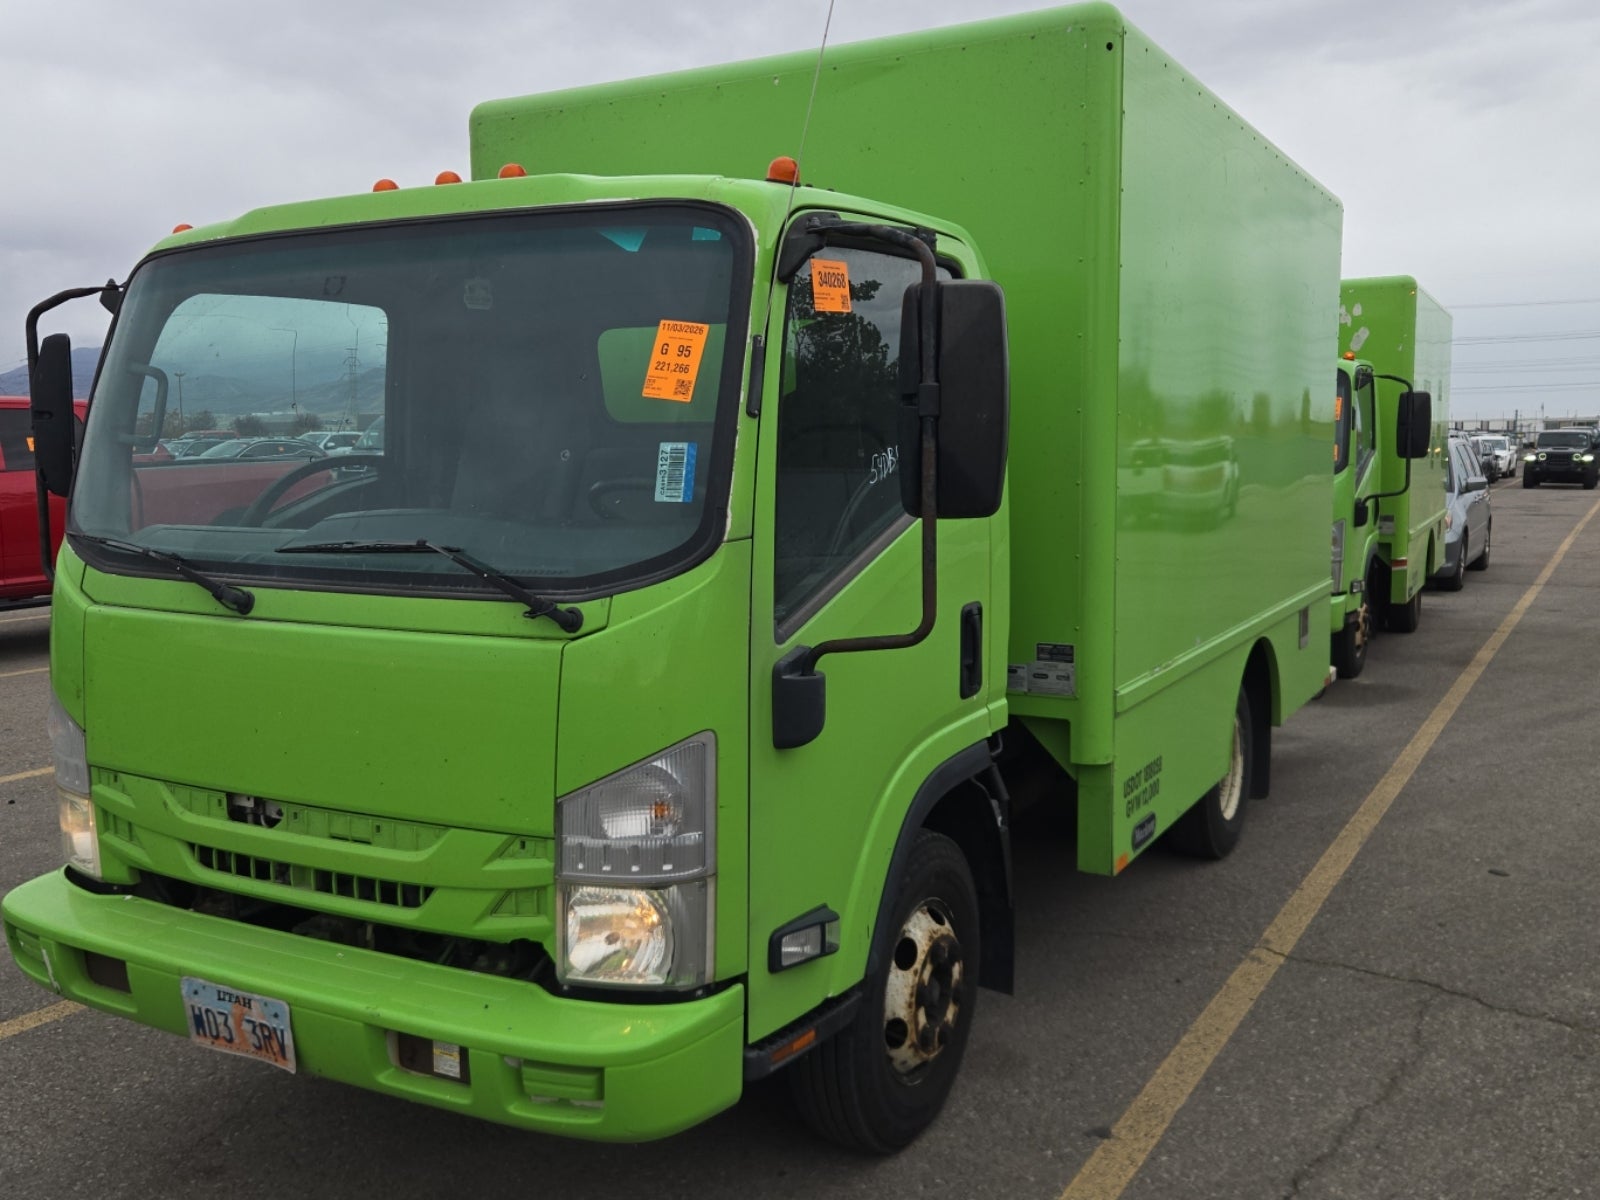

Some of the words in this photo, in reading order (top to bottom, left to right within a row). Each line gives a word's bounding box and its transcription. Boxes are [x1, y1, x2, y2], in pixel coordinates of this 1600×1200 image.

[818, 271, 846, 288] 340268
[662, 323, 704, 335] 11/03/2026
[661, 343, 669, 355] G
[677, 345, 692, 358] 95
[655, 361, 690, 373] 221,266
[216, 989, 253, 1009] UTAH
[244, 1017, 287, 1061] 3RV
